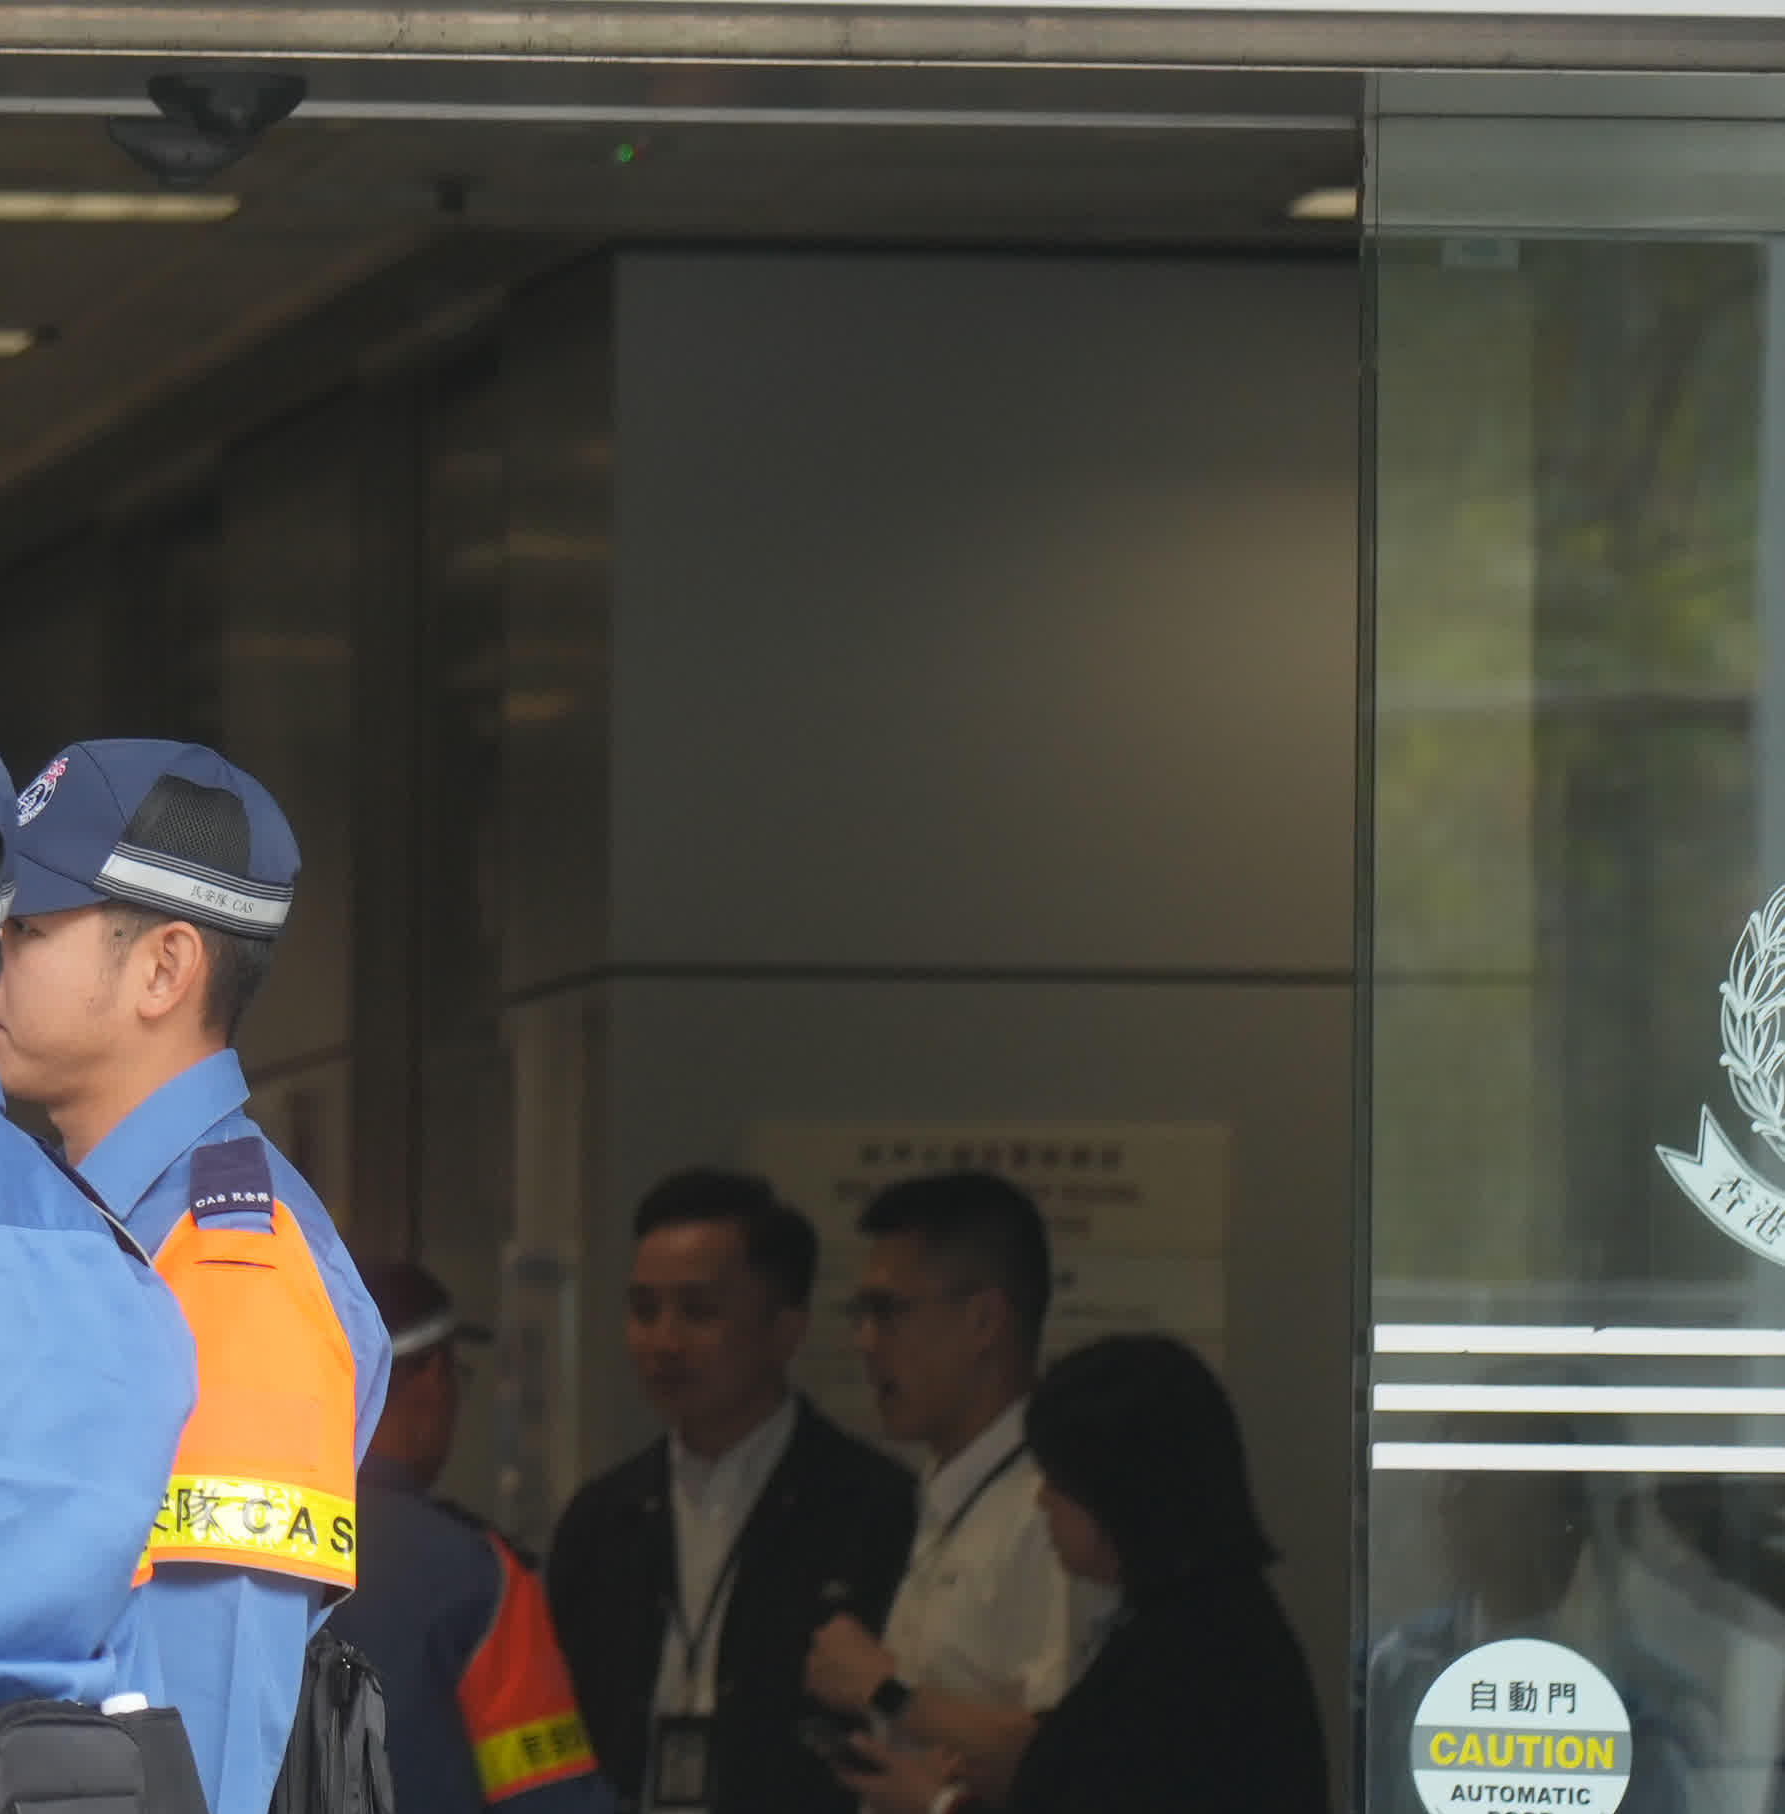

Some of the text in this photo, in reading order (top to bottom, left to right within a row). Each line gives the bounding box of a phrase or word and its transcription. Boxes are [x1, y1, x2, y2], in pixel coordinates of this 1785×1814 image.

[242, 1497, 355, 1554] CAS
[1470, 1680, 1577, 1714] 自動門
[1429, 1731, 1615, 1770] CAUTION
[1450, 1784, 1591, 1806] AUTOMATIC
